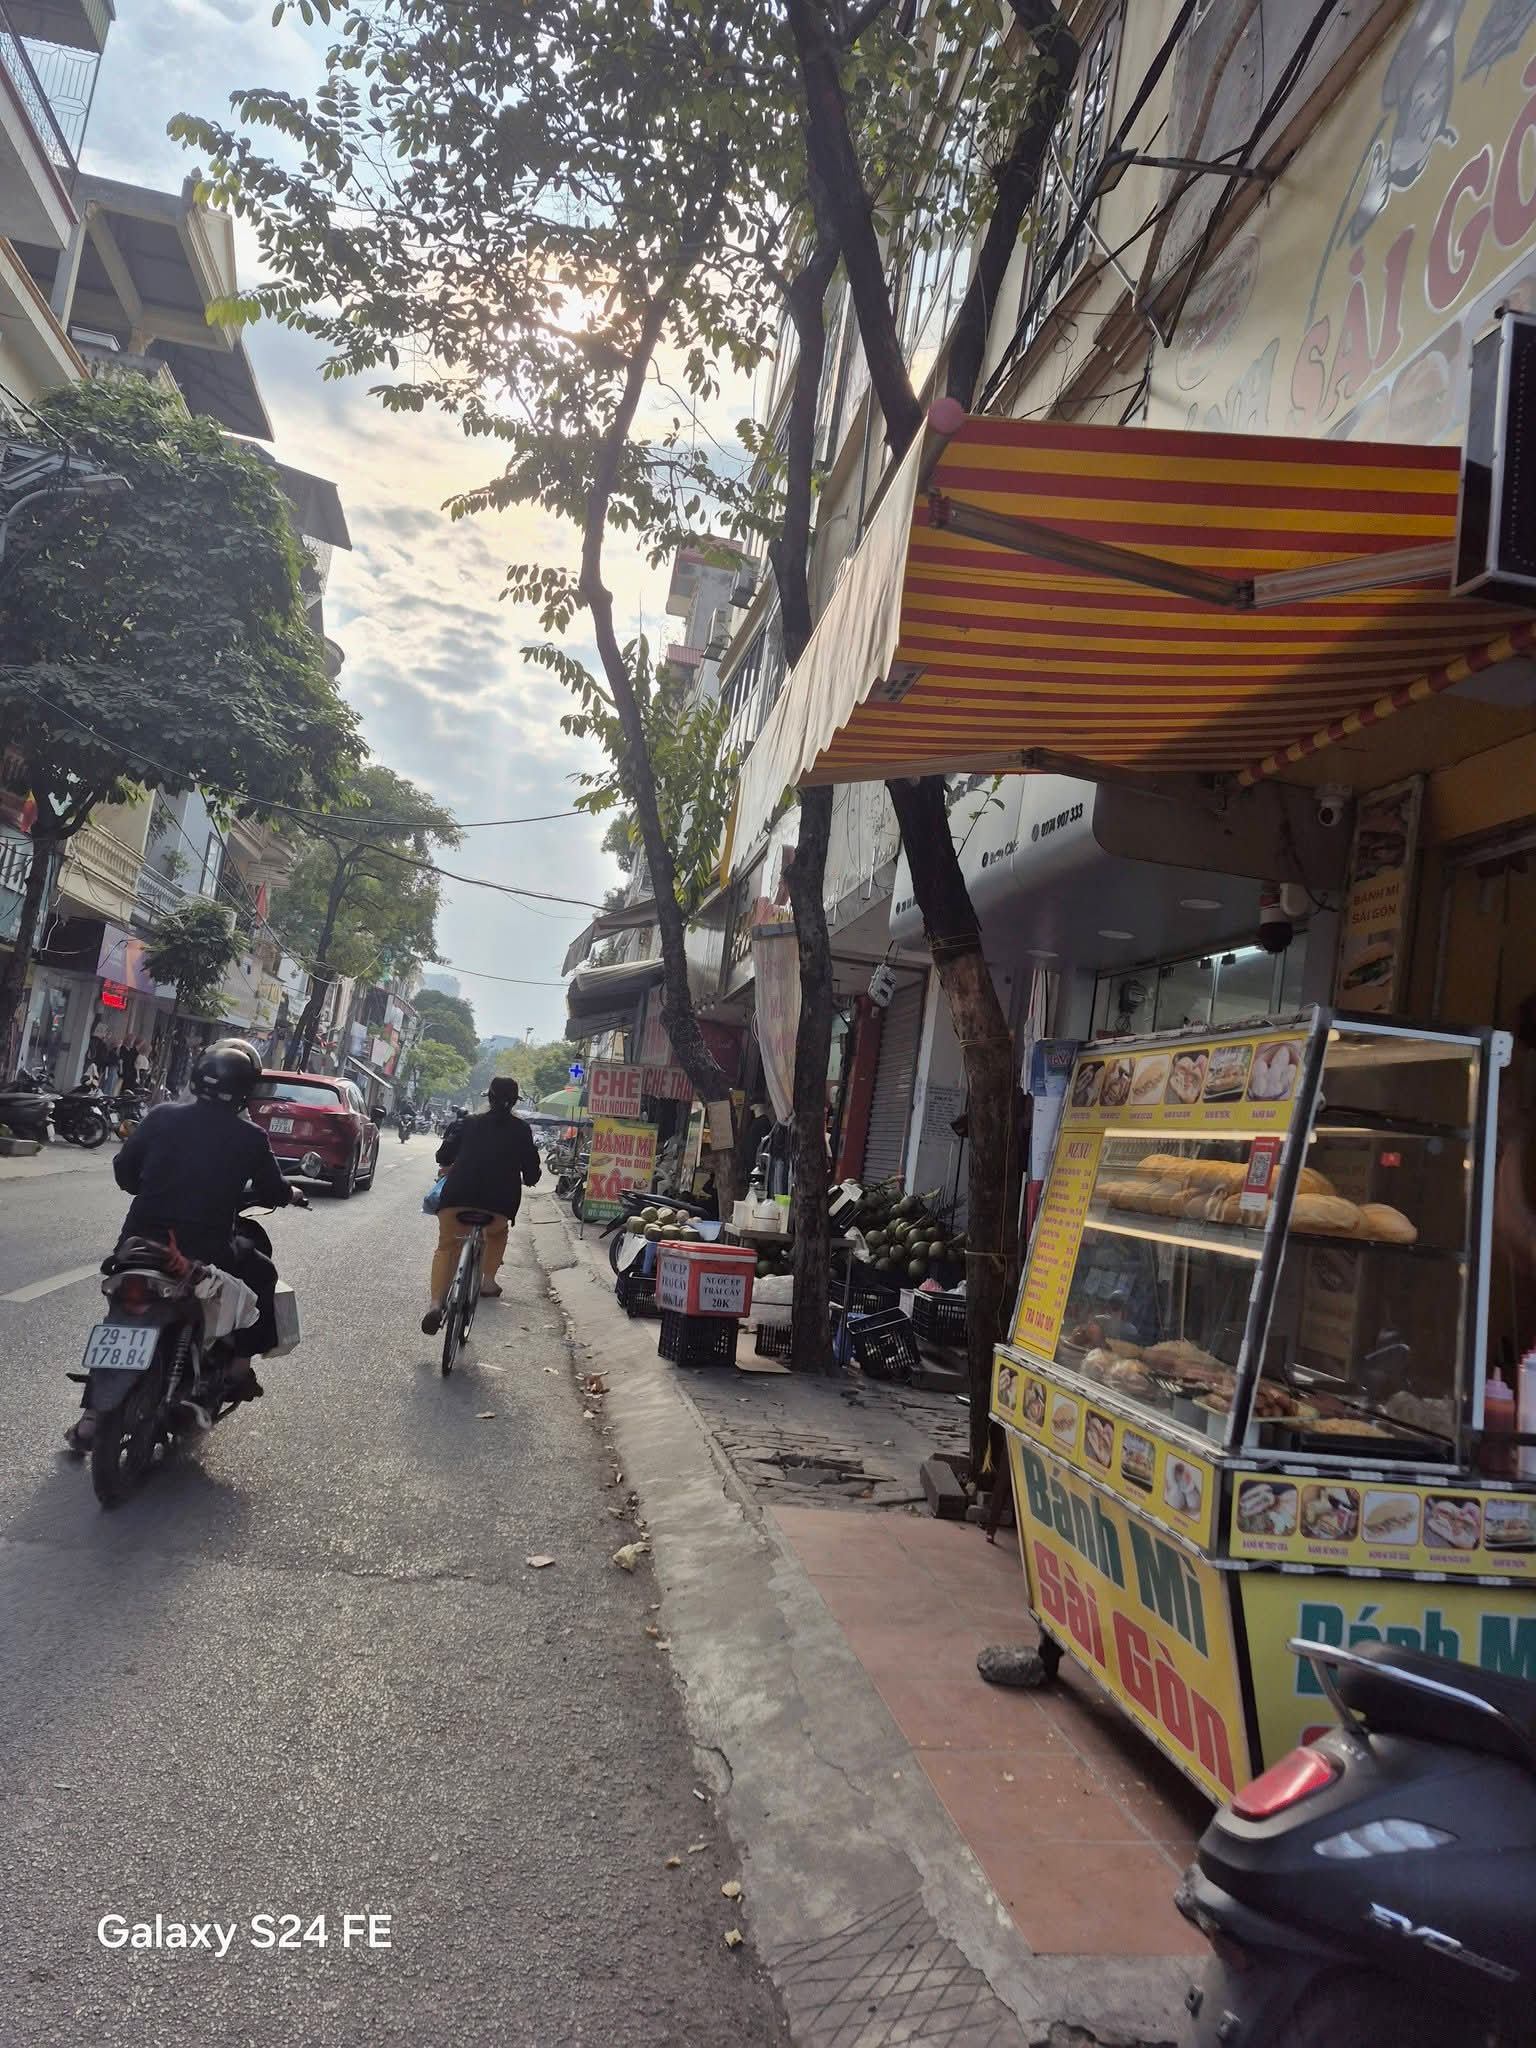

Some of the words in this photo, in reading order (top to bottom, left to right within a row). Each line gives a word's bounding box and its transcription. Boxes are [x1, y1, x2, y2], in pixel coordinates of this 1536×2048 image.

[1070, 803, 1084, 822] 333
[592, 1068, 641, 1098] CHÈ
[712, 1298, 730, 1308] 20K
[99, 1328, 148, 1347] 29-T1
[1021, 1444, 1125, 1590] Bánh
[1128, 1518, 1209, 1659] Mì
[1033, 1539, 1106, 1669] Sài
[1112, 1609, 1236, 1795] Gòn
